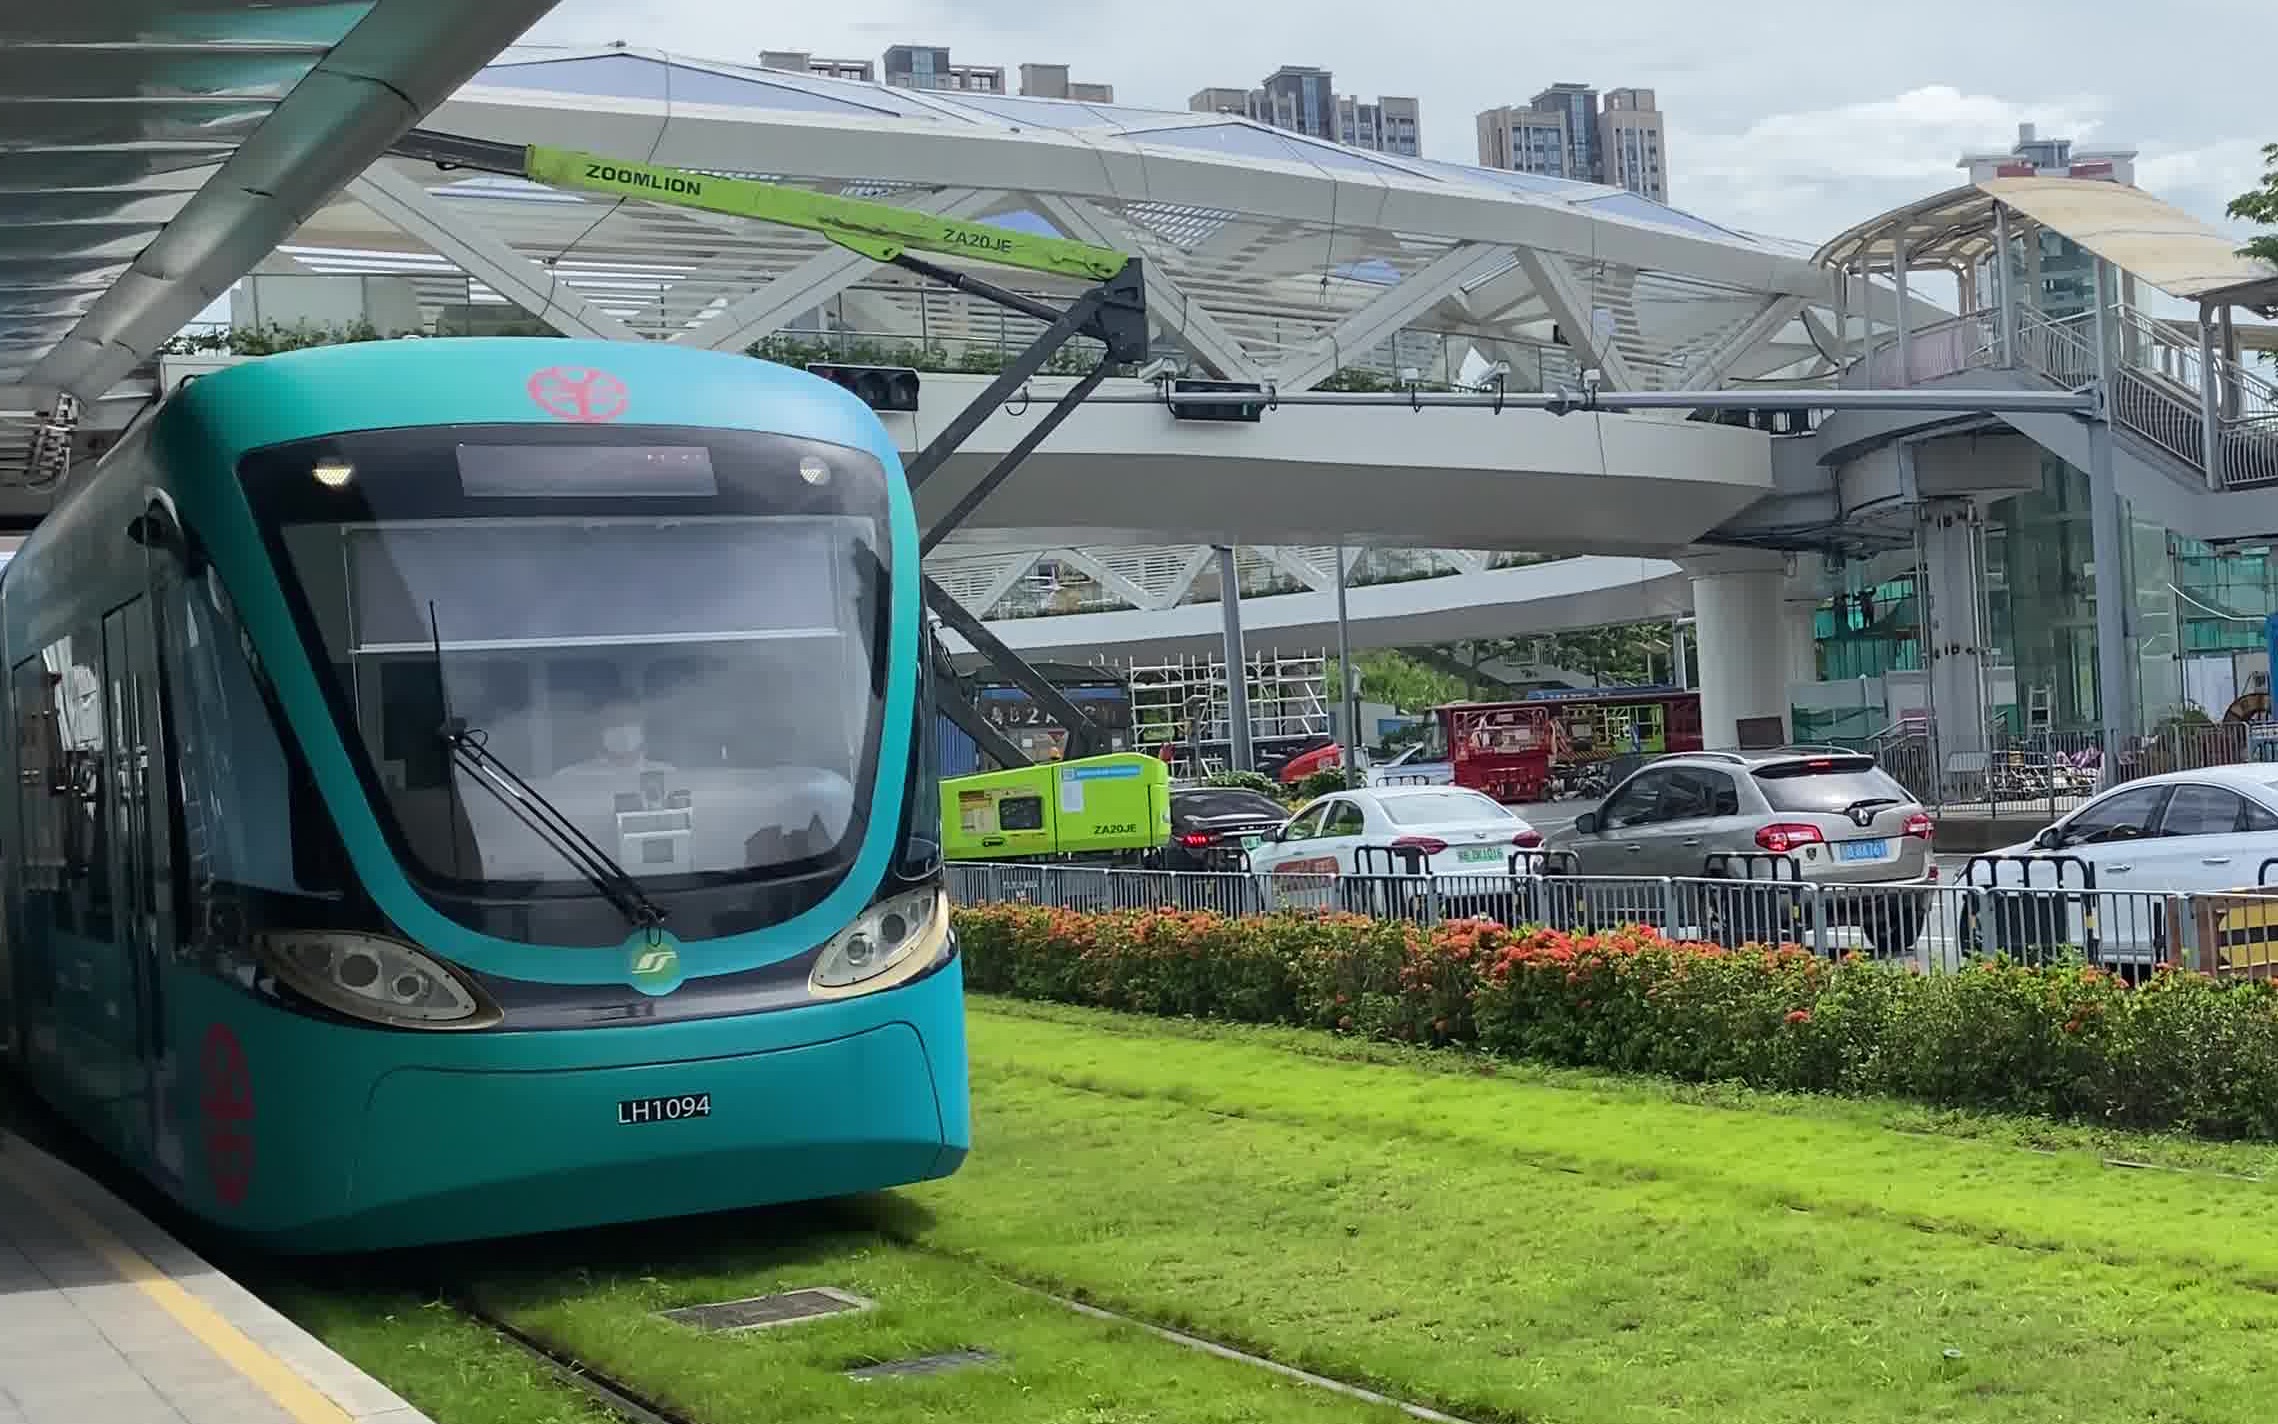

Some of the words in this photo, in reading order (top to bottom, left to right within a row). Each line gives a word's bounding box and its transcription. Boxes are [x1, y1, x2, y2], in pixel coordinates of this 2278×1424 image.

[584, 163, 701, 196] ZOOMLION
[943, 228, 1012, 254] ZA20JE
[1094, 823, 1137, 835] ZA20JE
[618, 1095, 711, 1124] LH1094
